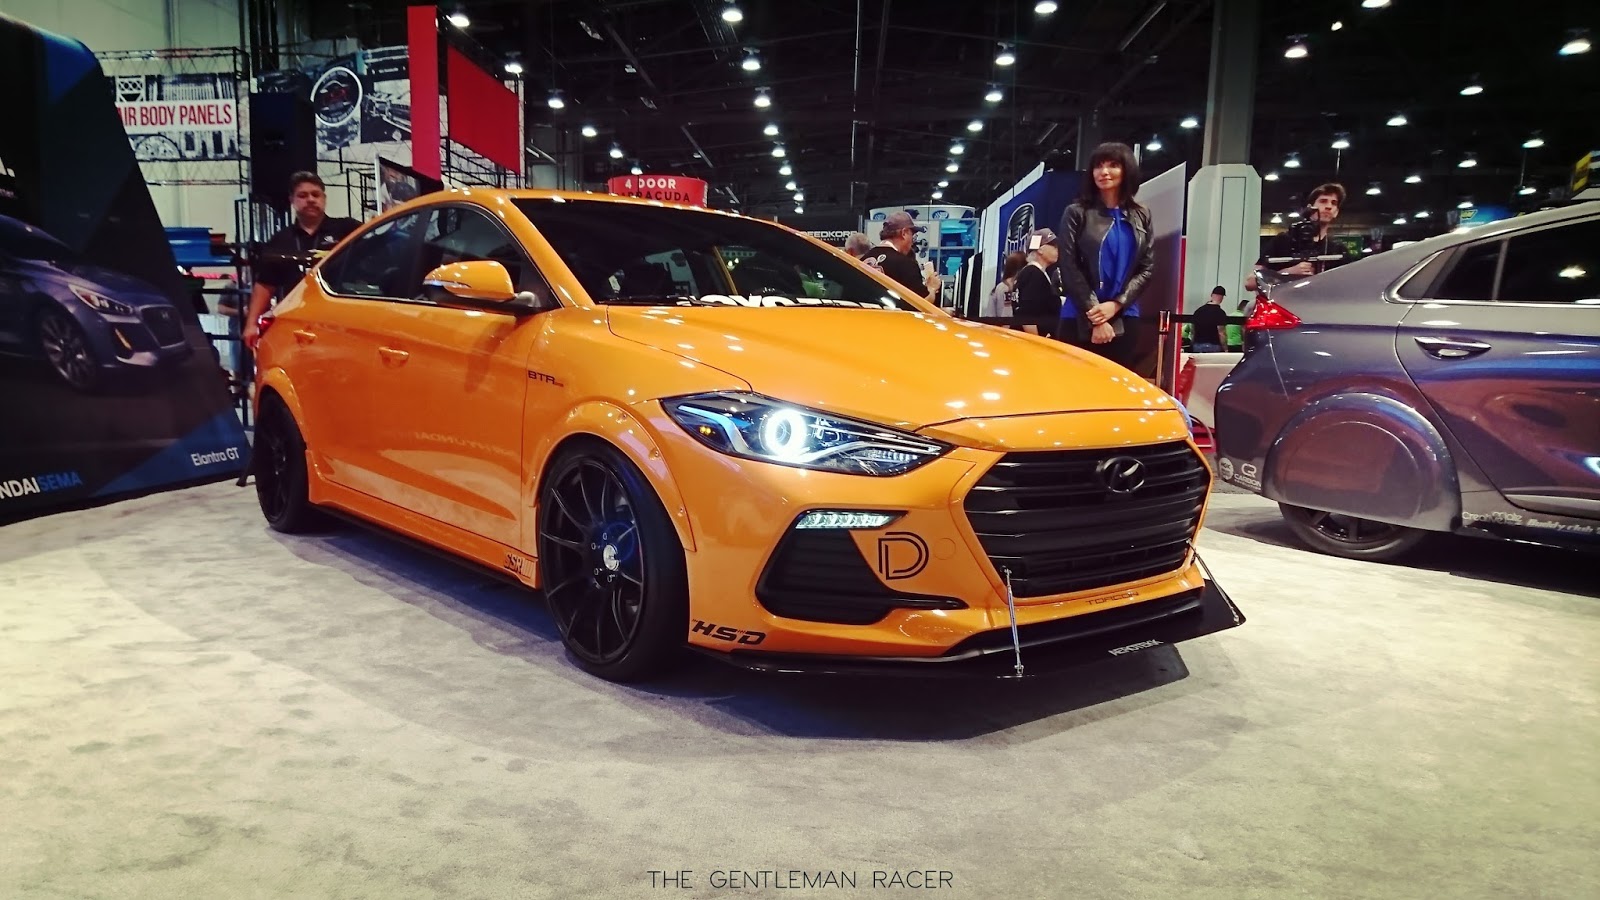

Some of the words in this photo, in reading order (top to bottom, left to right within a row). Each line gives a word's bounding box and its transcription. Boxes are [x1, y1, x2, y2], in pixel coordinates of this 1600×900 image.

[140, 106, 175, 125] BODY
[179, 104, 232, 124] PANELS
[625, 179, 632, 189] 4
[638, 178, 676, 189] DOOR
[617, 191, 690, 202] RRACUDA
[528, 370, 555, 384] BTR
[191, 451, 227, 466] Elantra
[227, 447, 240, 460] GT
[692, 620, 766, 645] HSD
